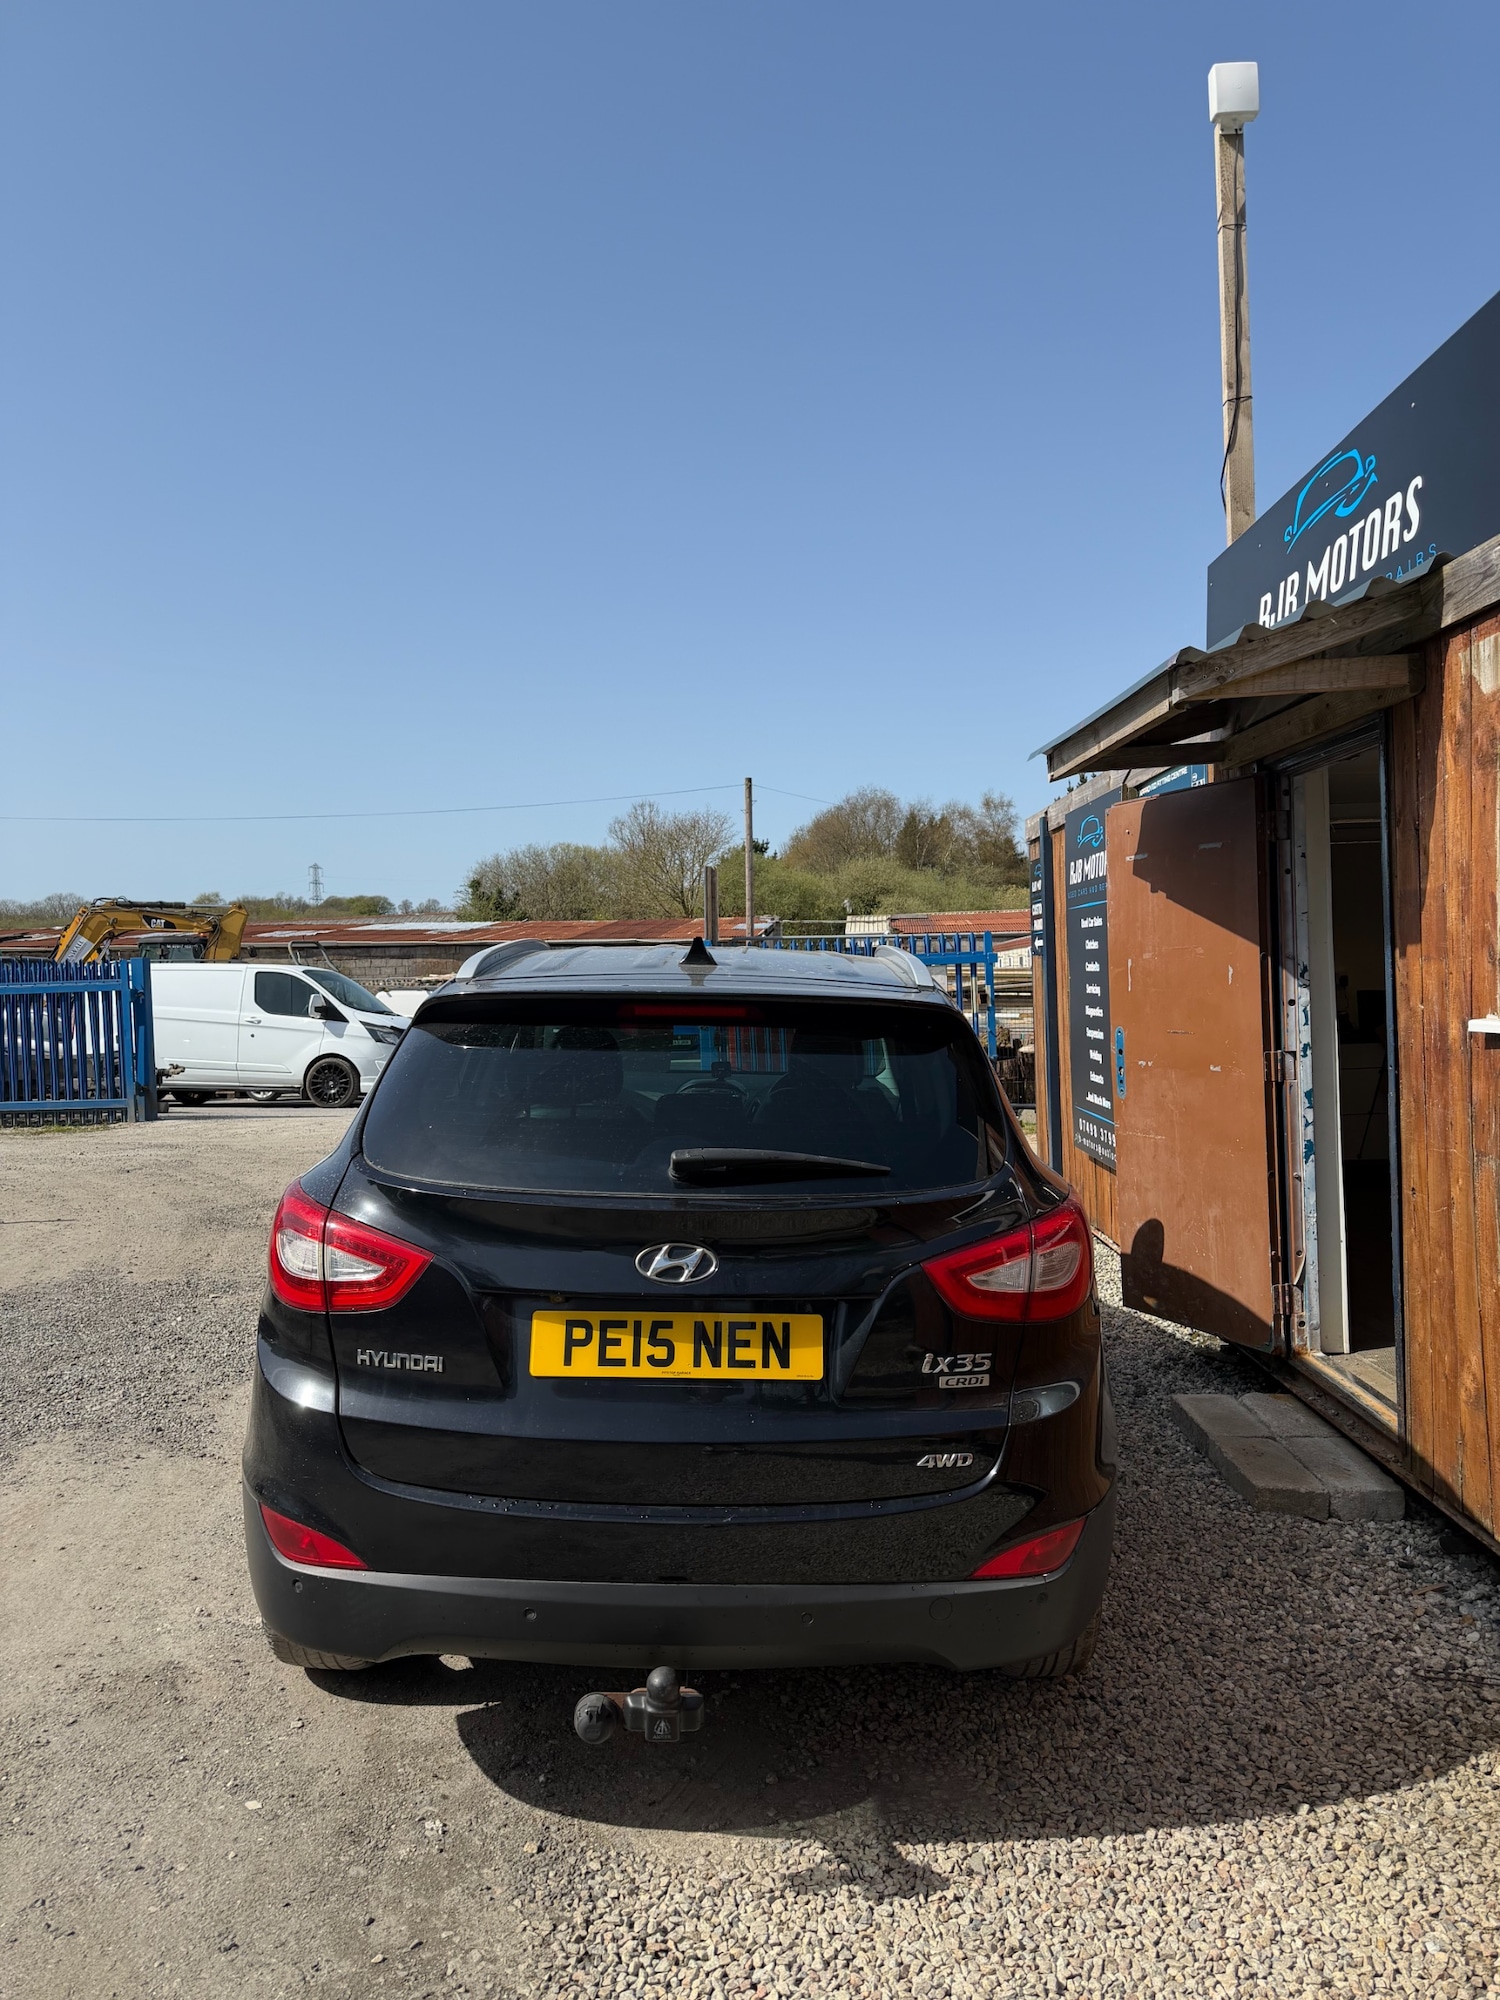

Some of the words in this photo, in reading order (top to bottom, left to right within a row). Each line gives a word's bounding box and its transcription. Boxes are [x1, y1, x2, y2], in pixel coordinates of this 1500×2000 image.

[1305, 475, 1423, 604] MOTORS
[1170, 766, 1188, 781] CENTRE
[1069, 858, 1083, 885] RJB
[151, 919, 166, 928] CAT
[563, 1319, 676, 1368] PE15
[693, 1321, 790, 1369] NEN
[357, 1348, 443, 1372] HYUNDAI
[921, 1353, 992, 1373] ix35
[945, 1376, 985, 1387] CRDi
[916, 1453, 974, 1468] 4WD
